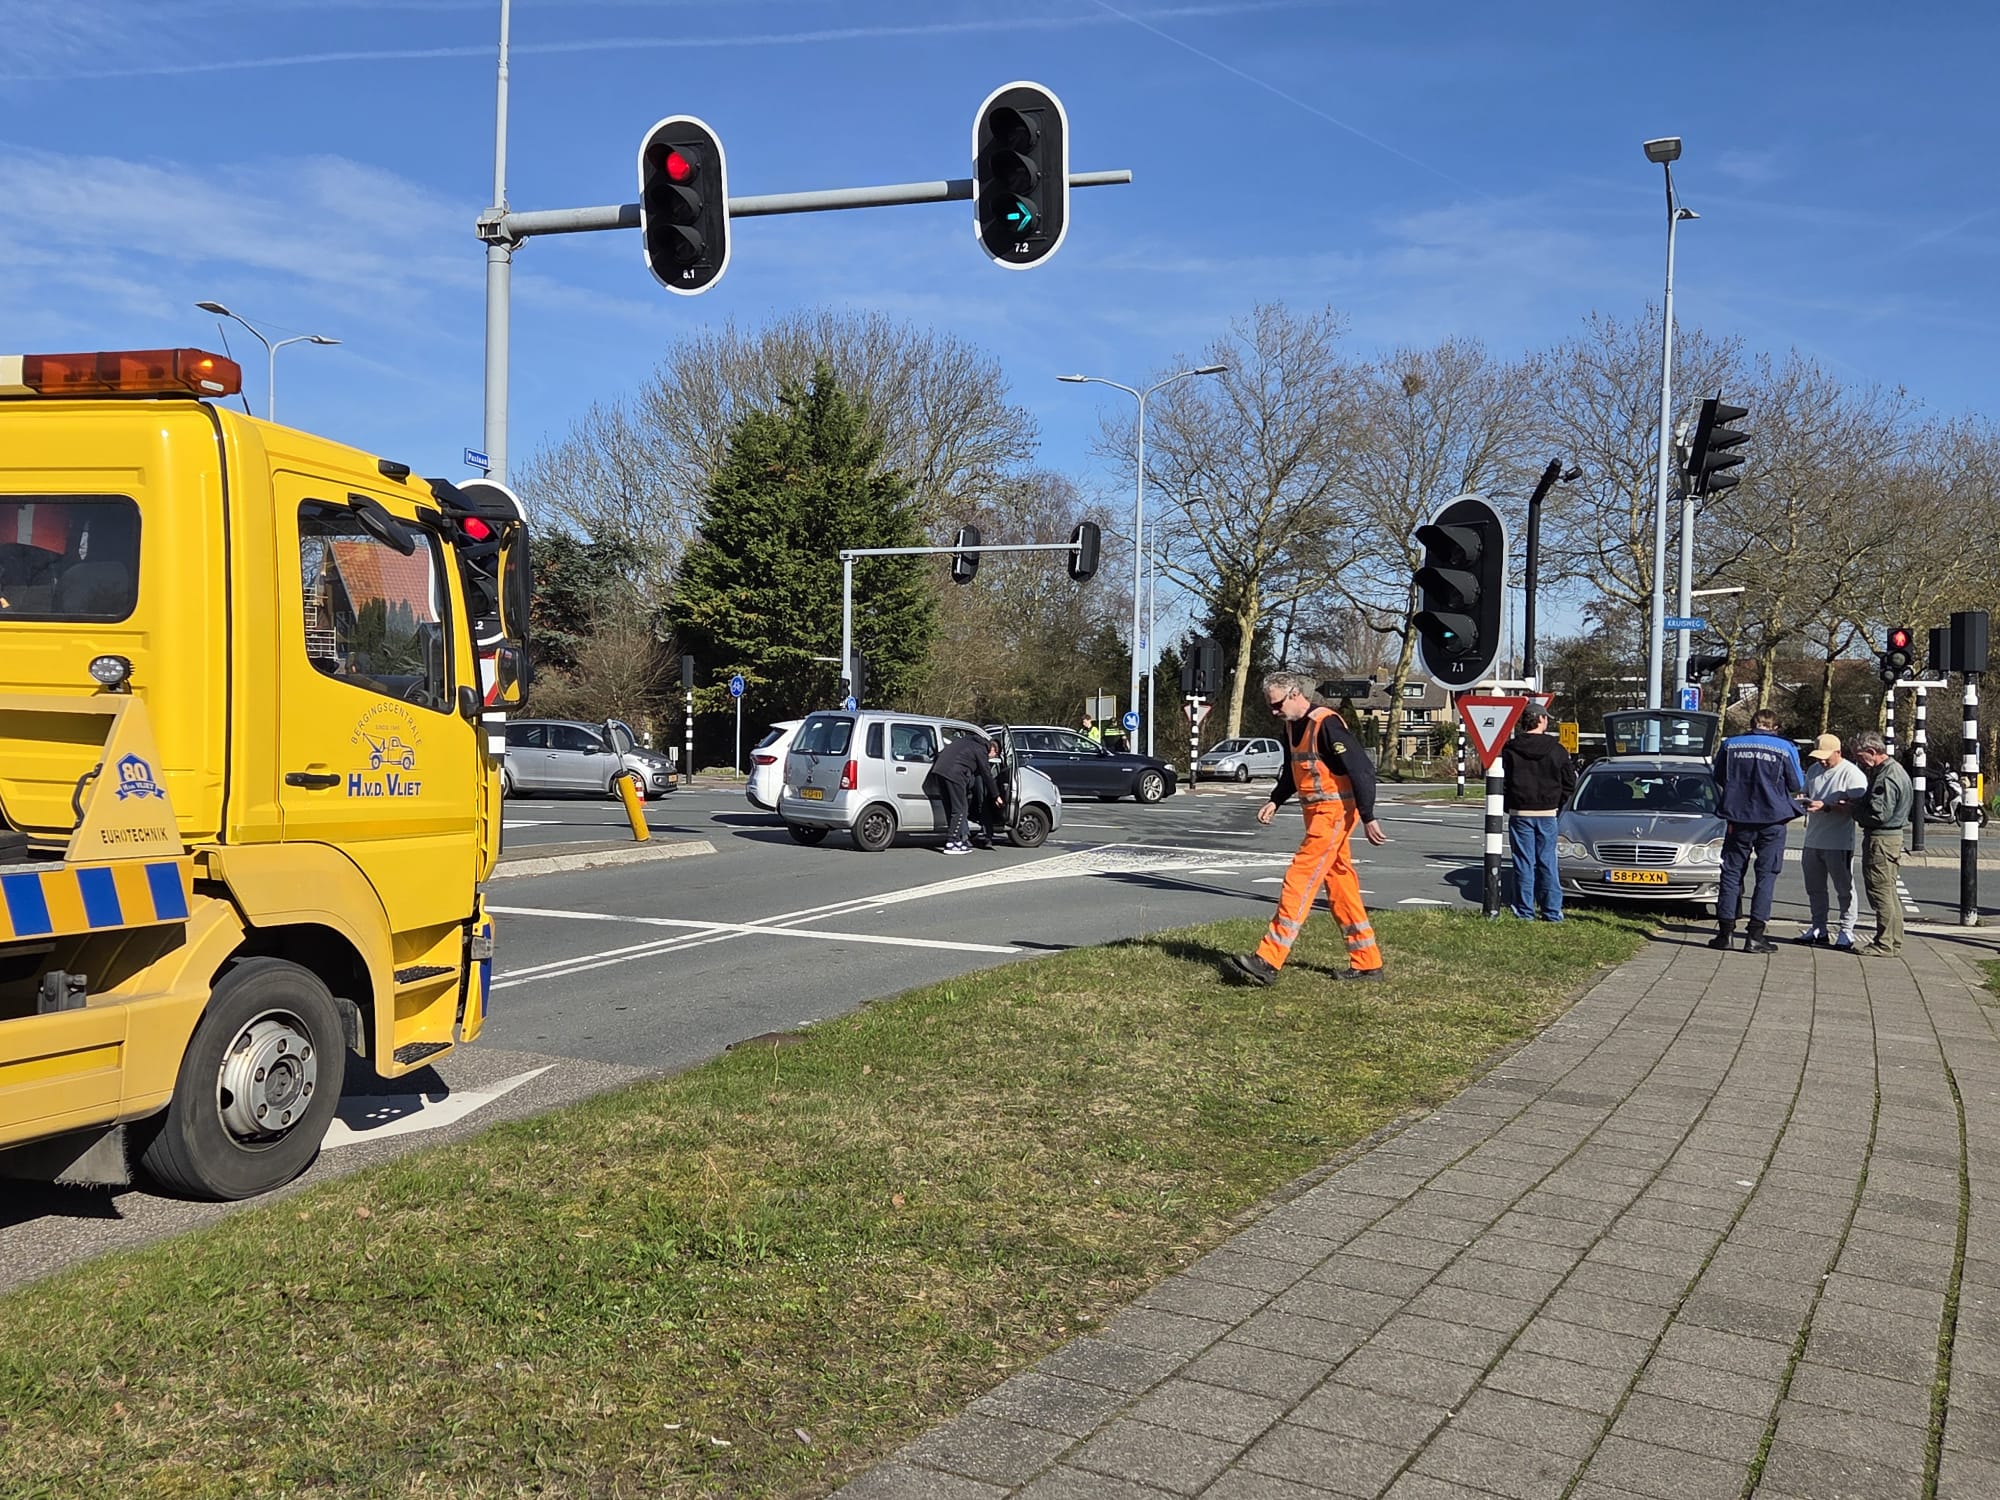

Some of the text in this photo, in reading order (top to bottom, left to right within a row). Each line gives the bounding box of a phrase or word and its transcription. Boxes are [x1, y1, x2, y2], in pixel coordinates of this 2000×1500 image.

[1014, 242, 1029, 253] 7.2
[474, 620, 485, 630] .2
[1451, 662, 1464, 673] 7.1
[351, 702, 422, 747] BERGINGSCENTRALE
[121, 762, 148, 781] 80
[100, 827, 168, 844] EUROTECHNIK
[1613, 871, 1663, 882] 58-PX-XN
